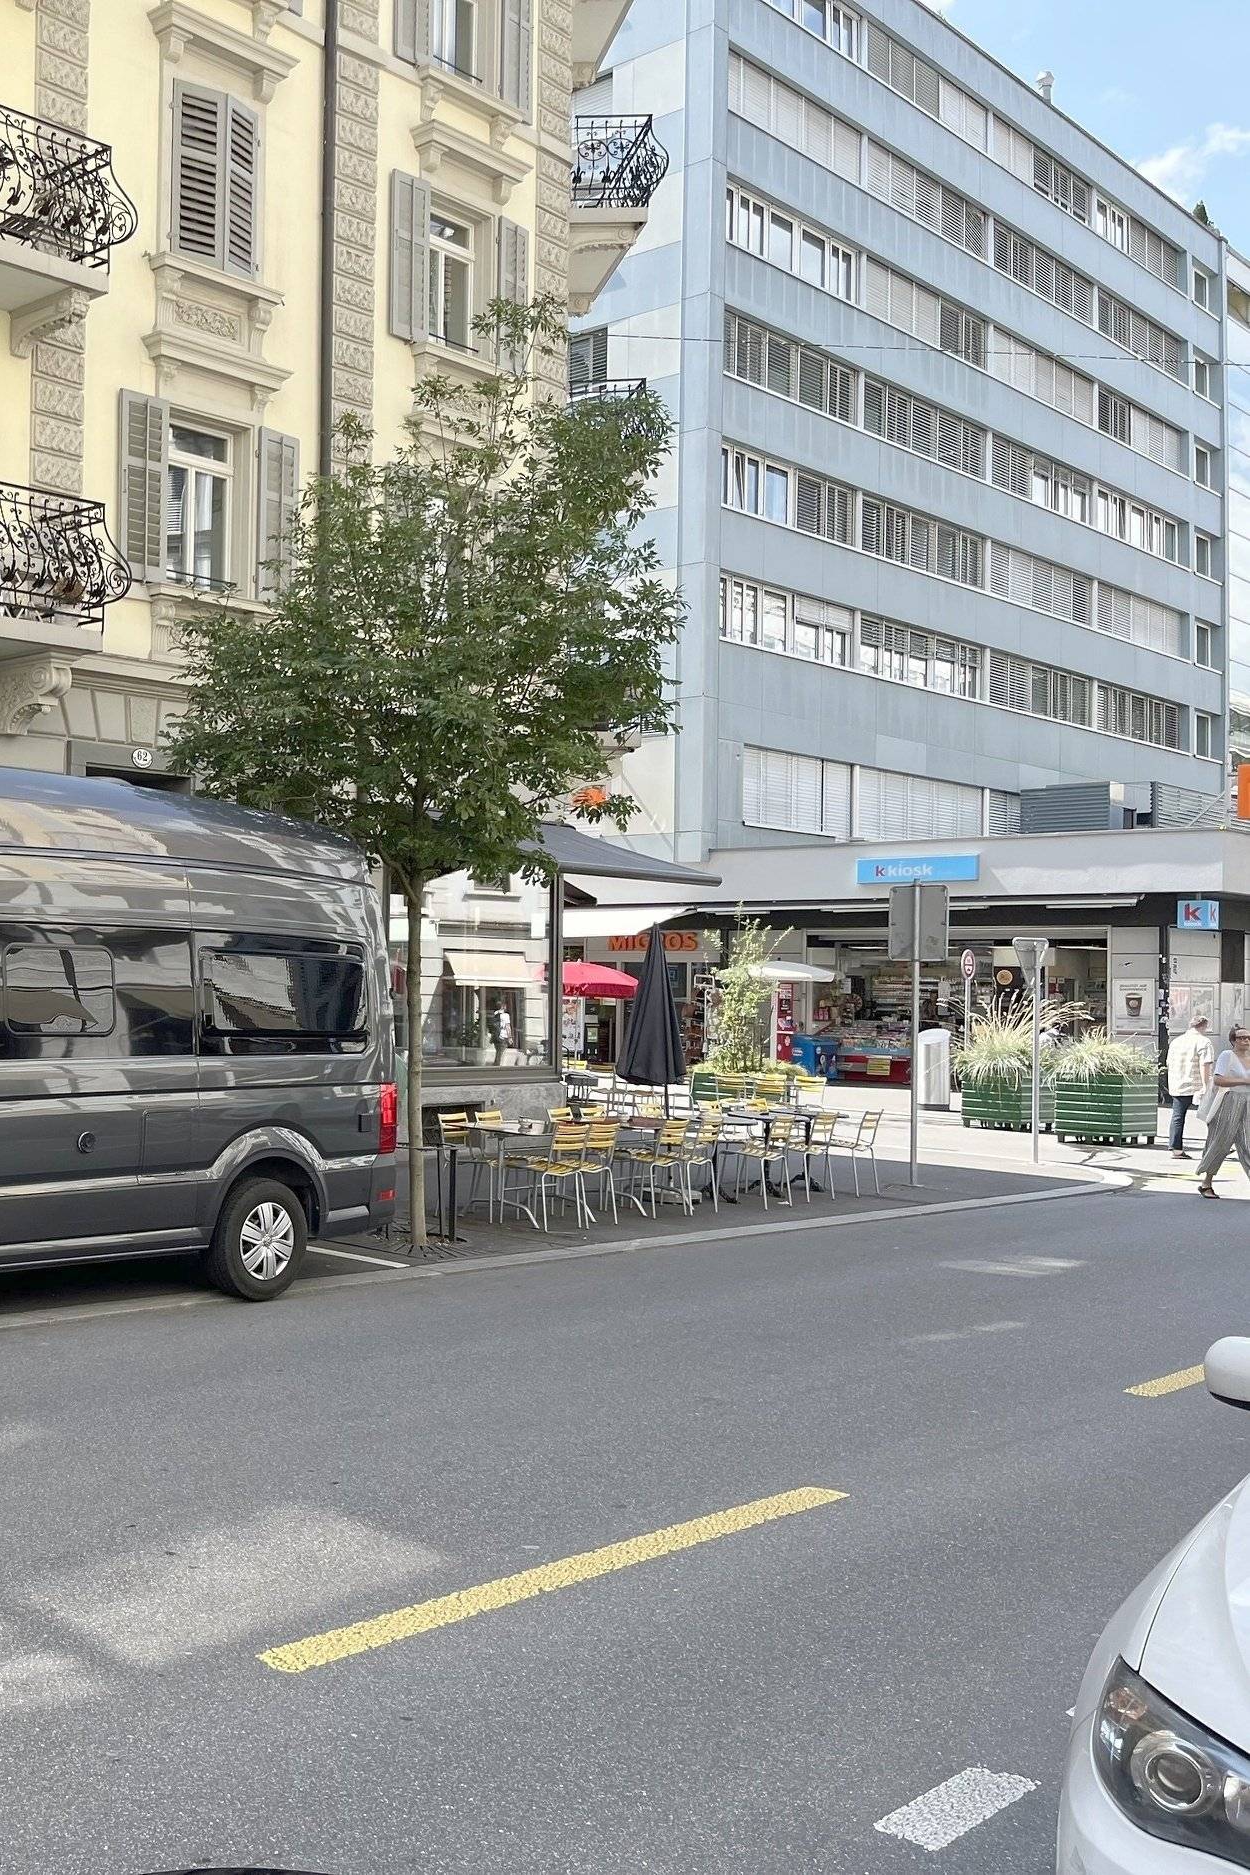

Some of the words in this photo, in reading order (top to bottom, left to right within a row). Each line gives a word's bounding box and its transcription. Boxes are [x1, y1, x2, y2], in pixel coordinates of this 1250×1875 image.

[137, 750, 148, 762] 62
[888, 861, 933, 877] kiosk
[1184, 903, 1202, 921] k
[608, 932, 698, 951] MIGOS
